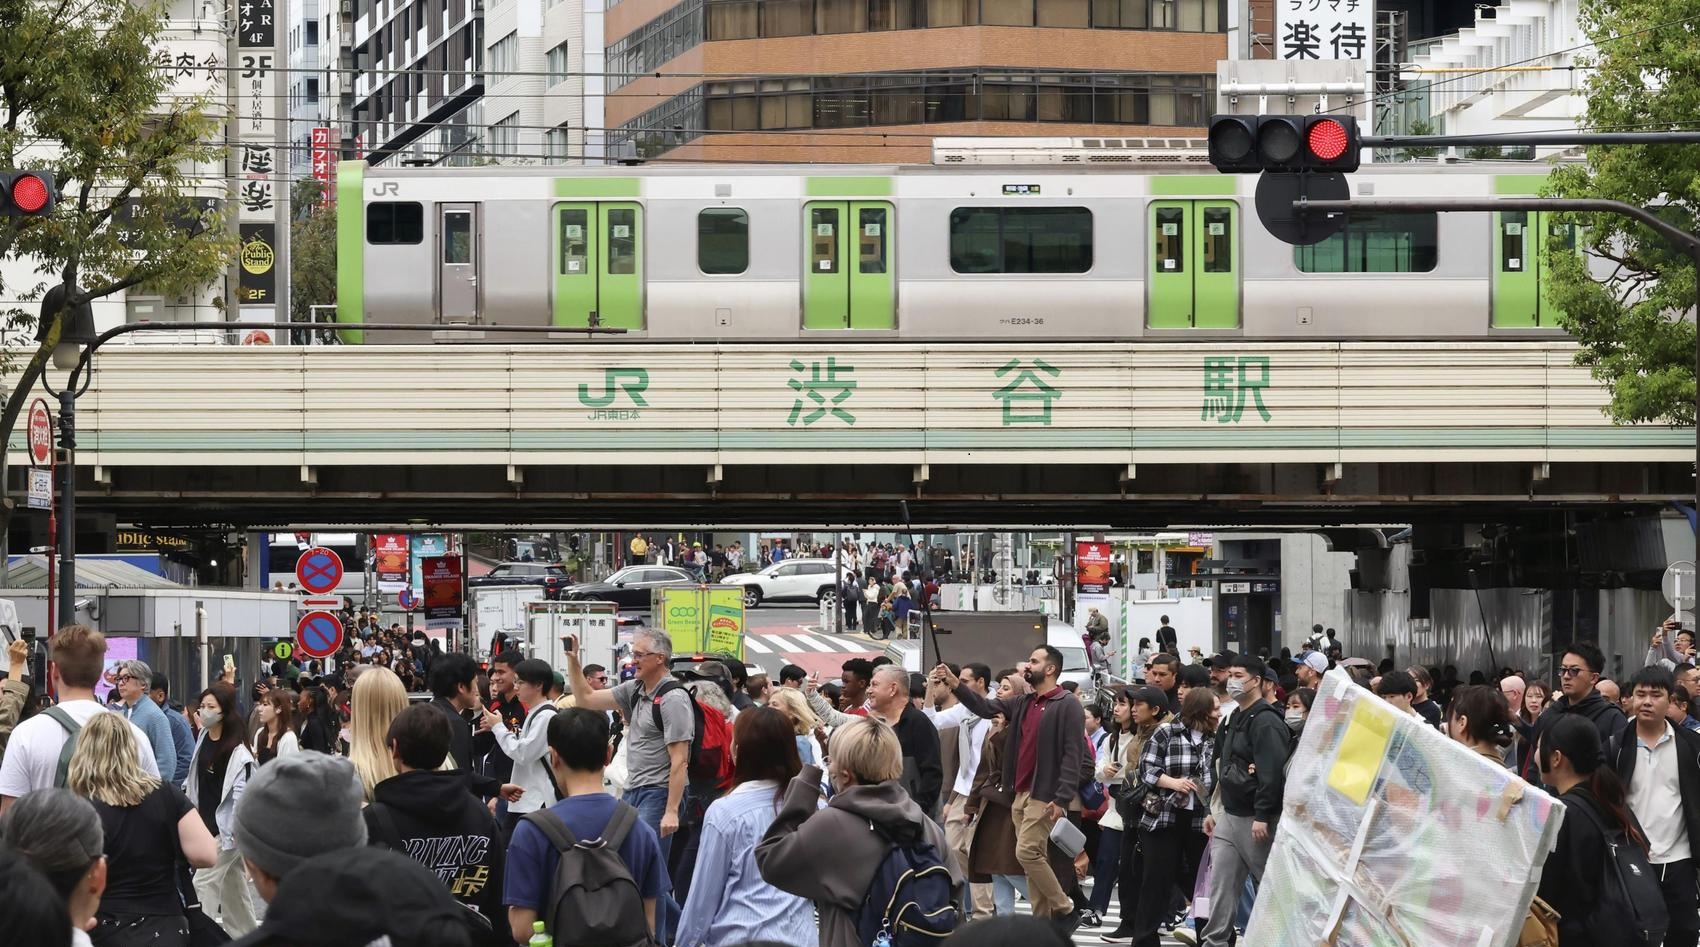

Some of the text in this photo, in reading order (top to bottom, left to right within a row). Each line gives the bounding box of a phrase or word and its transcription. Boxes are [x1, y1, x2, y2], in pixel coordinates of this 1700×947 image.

[249, 33, 263, 42] 4F
[1283, 20, 1366, 59] 楽待
[242, 56, 271, 78] 3F
[373, 182, 398, 195] JR
[245, 250, 271, 258] Public
[249, 290, 266, 299] 2F
[578, 368, 649, 407] JR
[587, 409, 641, 420] JR東日本
